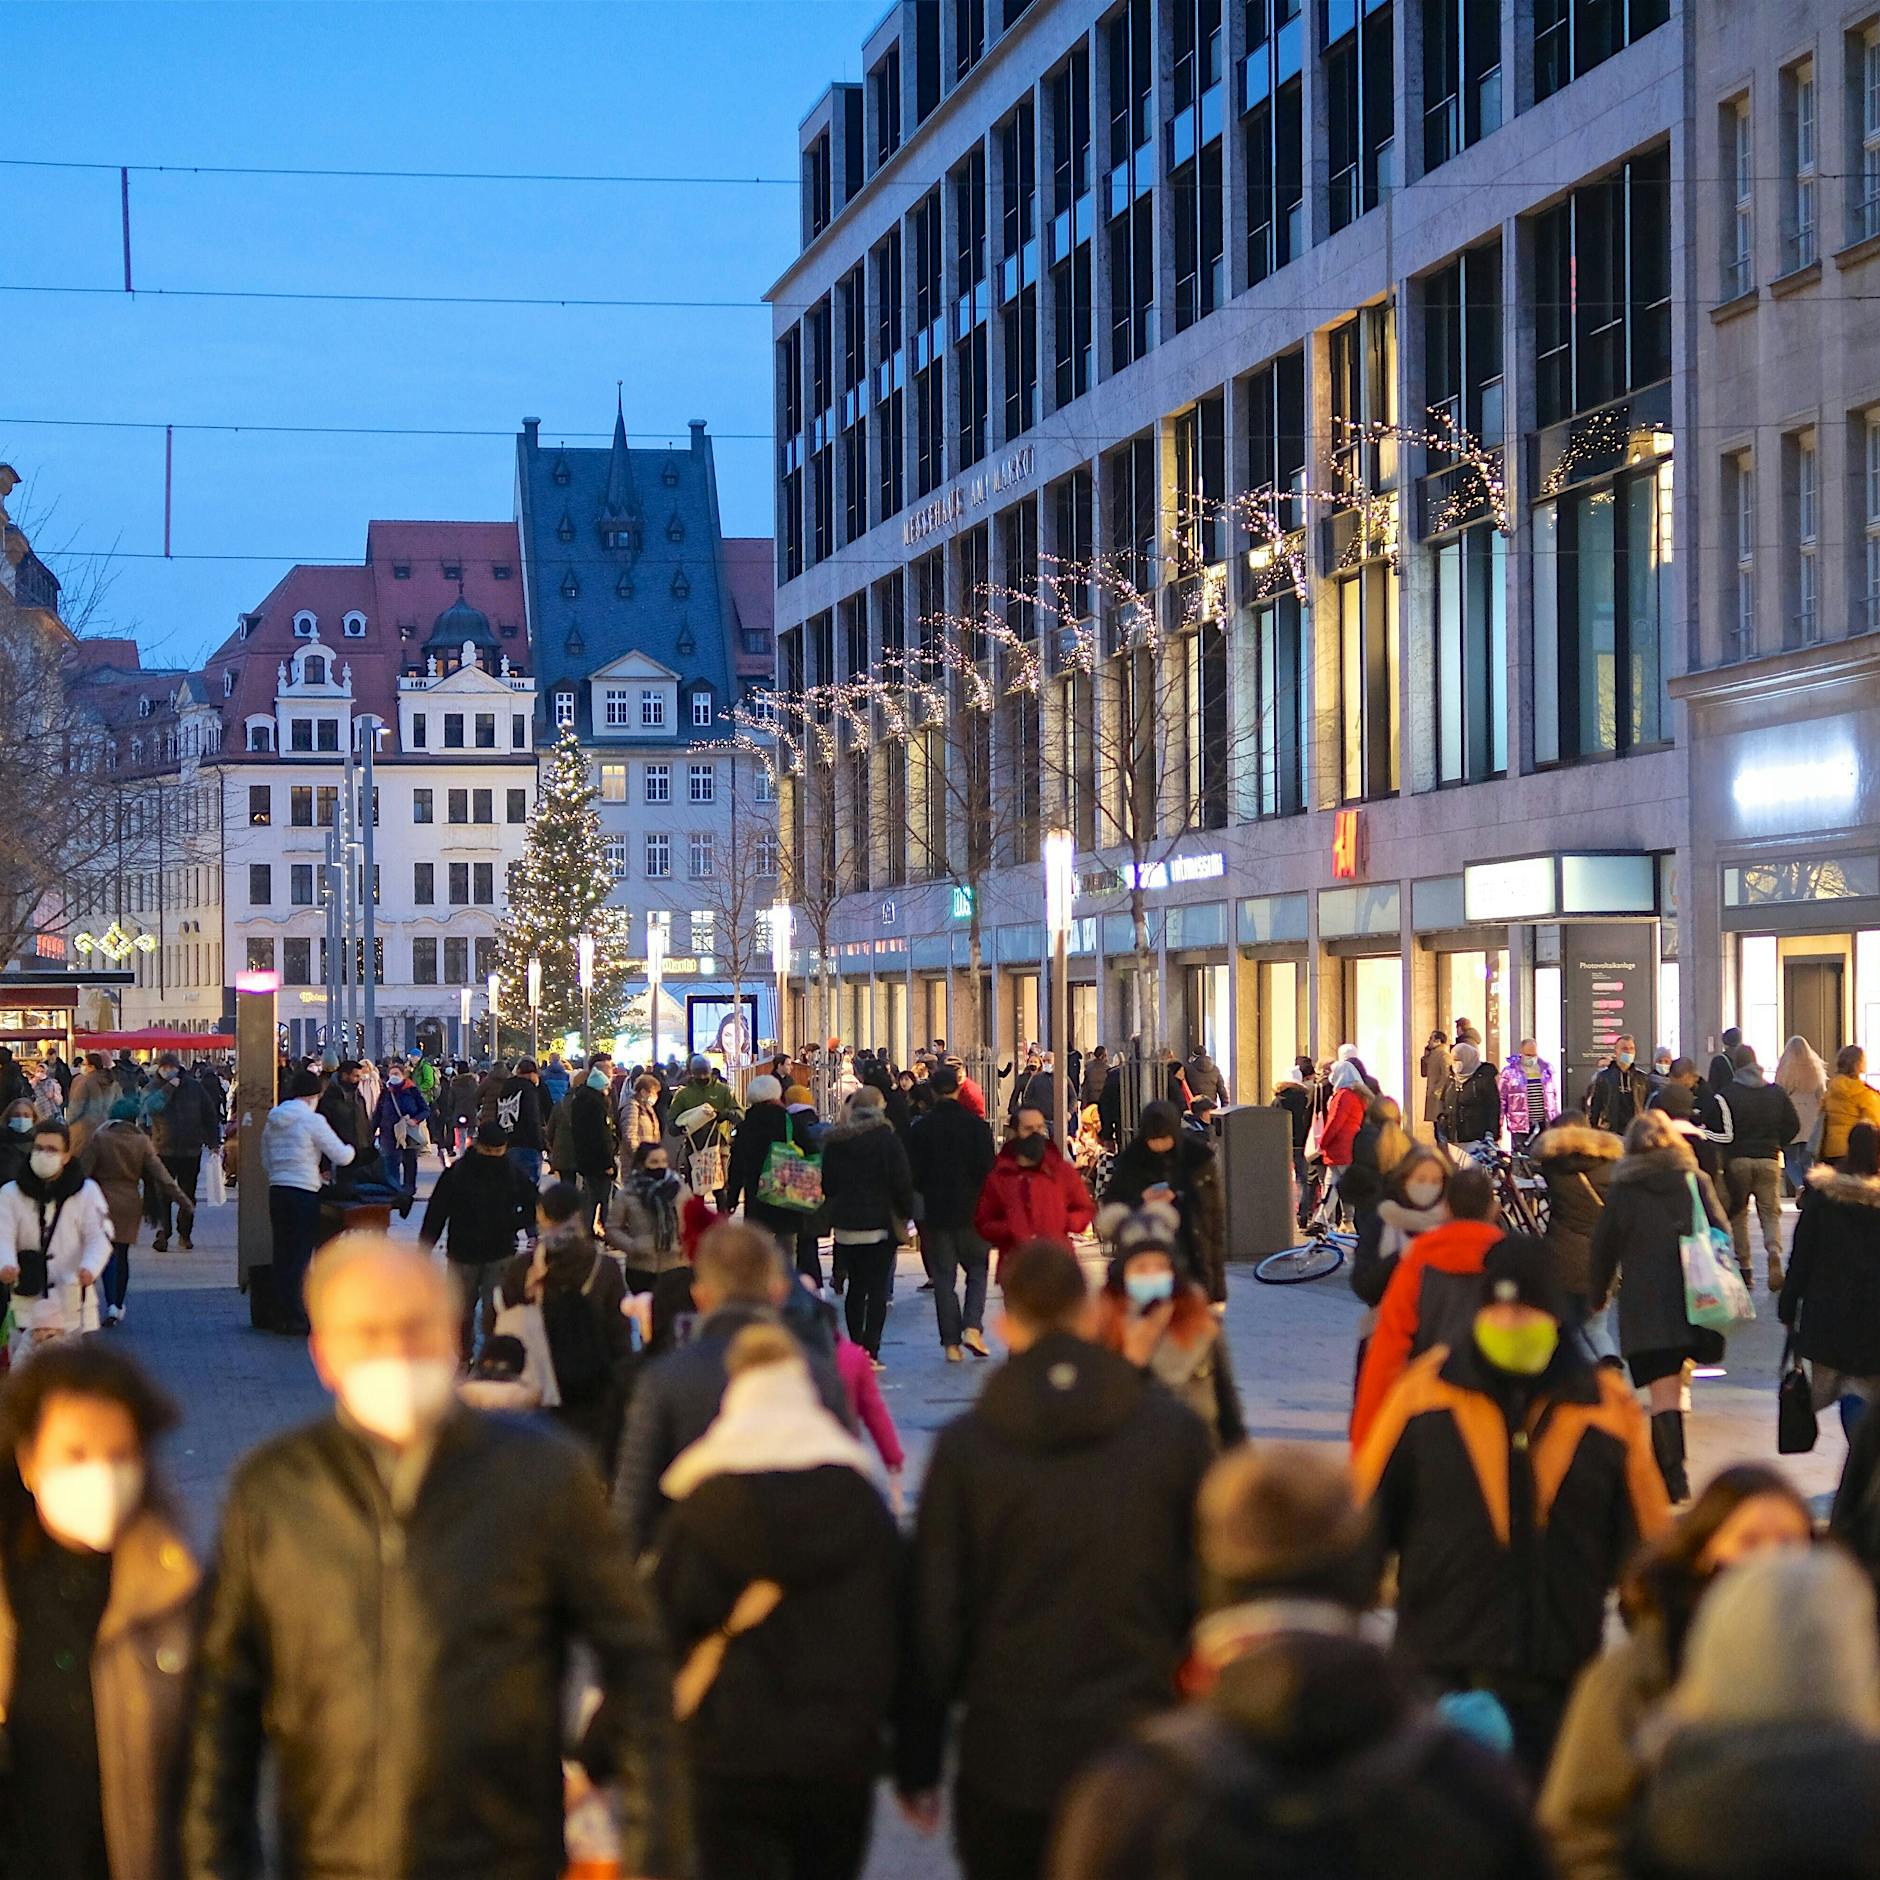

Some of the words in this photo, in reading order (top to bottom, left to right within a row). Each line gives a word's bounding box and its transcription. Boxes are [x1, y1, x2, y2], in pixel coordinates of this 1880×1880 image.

[903, 487, 964, 546] MESSEHAUS
[971, 473, 989, 507] AM
[993, 444, 1035, 493] MARKT
[1579, 962, 1635, 970] Photovoltaikanlage
